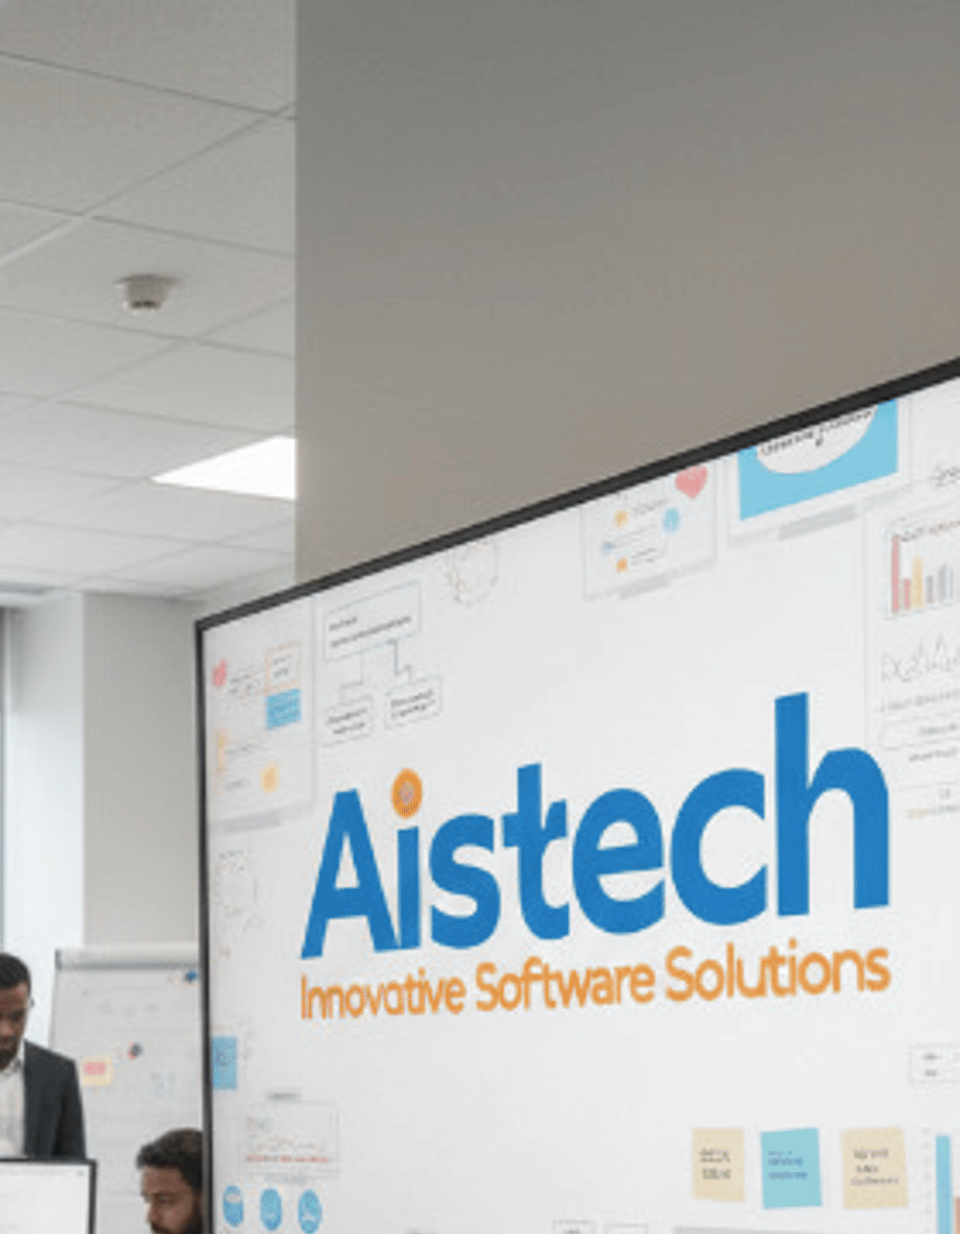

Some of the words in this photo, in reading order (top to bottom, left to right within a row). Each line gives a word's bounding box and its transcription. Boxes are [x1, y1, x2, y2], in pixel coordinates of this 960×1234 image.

[301, 692, 890, 959] Aistech
[301, 967, 466, 1020] Innovative
[475, 956, 655, 1012] Software
[665, 938, 891, 1001] Solutions
